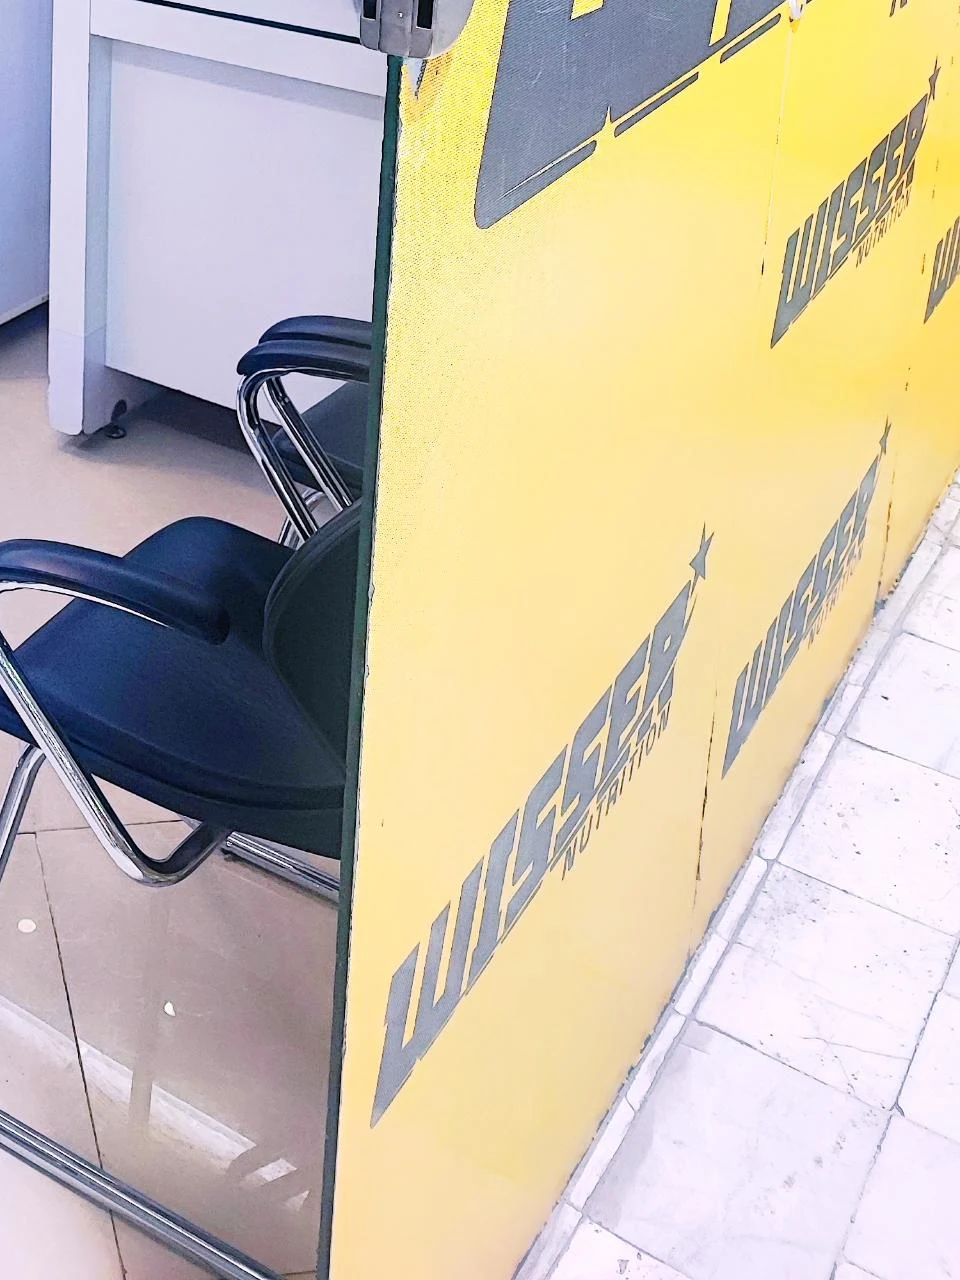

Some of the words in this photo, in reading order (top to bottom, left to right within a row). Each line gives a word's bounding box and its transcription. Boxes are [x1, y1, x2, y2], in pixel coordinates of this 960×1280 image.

[771, 93, 929, 349] WISSER
[855, 185, 911, 269] NUTRITION
[721, 454, 881, 780] WISSER
[370, 579, 693, 1129] WISSER
[561, 701, 672, 881] NUTRITION
